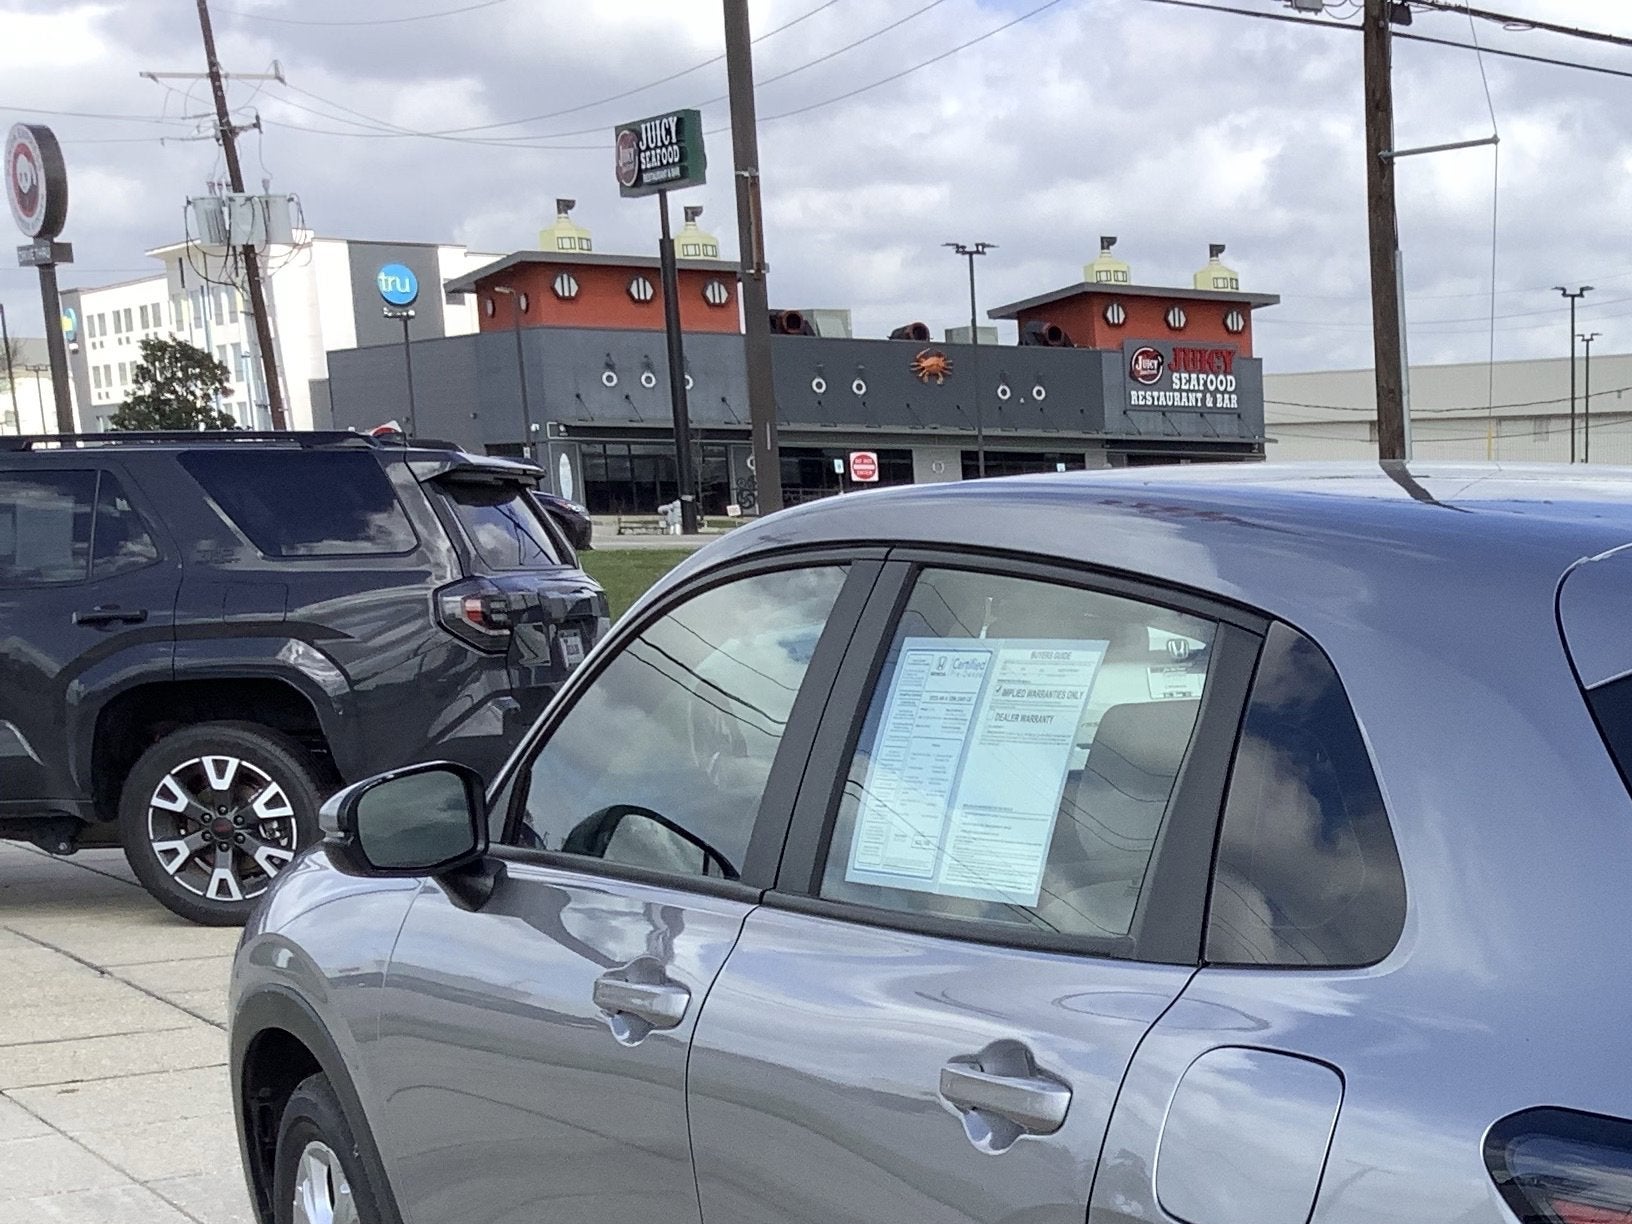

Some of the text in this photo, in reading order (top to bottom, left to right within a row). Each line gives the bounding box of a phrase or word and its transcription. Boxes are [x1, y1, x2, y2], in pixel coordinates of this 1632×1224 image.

[639, 116, 677, 151] JUICY
[640, 144, 680, 170] SEAFOOD
[378, 271, 411, 293] tru
[1168, 347, 1236, 374] JUICY
[1172, 372, 1236, 392] SEAFOOD
[1130, 390, 1238, 409] RESTAURANT & BAR
[1001, 687, 1085, 700] IMPLIED WARRANTIES ONLY
[994, 711, 1056, 725] DEALER WARRANTY
